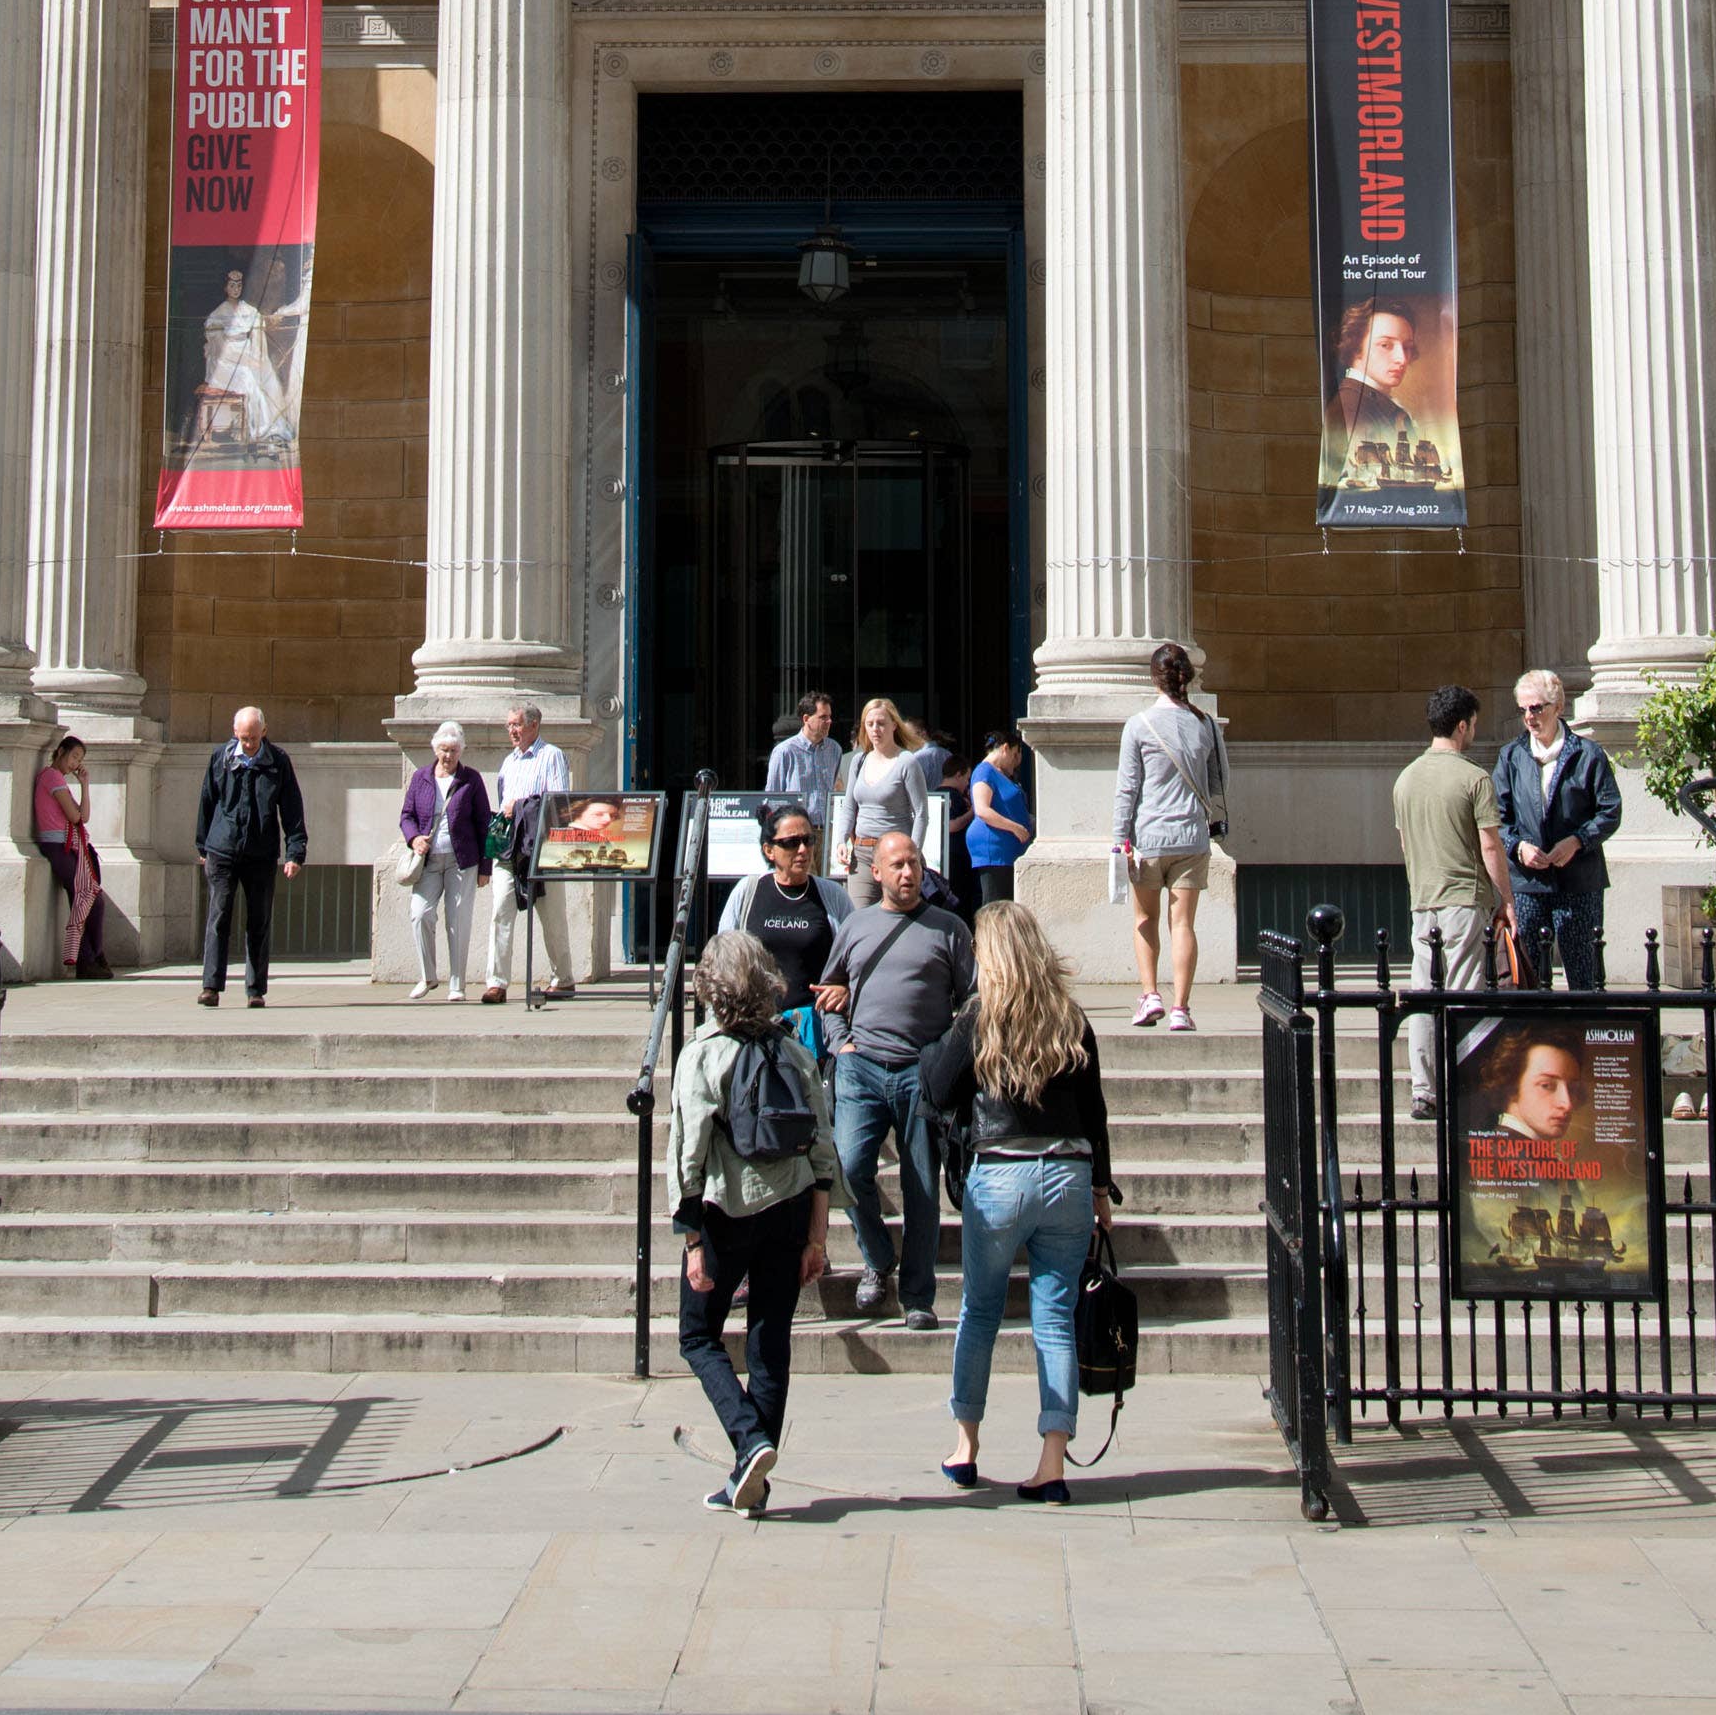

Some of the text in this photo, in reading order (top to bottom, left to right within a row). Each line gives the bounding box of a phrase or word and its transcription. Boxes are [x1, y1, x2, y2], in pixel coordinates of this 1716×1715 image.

[190, 7, 291, 45] MANET
[189, 48, 307, 87] FOR THE
[188, 90, 292, 129] PUBLIC
[187, 133, 251, 171] GIVE
[185, 175, 254, 213] NOW
[1343, 254, 1420, 268] An Episode of
[1343, 268, 1426, 280] the Grand Tour
[169, 503, 293, 515] www.ashmolean.org/manet
[1344, 505, 1355, 514] 17
[1396, 504, 1414, 517] Aug
[1416, 504, 1439, 514] 2012
[764, 919, 809, 929] ICELAND
[1585, 1030, 1634, 1042] ASHMOLEAN
[1478, 1130, 1495, 1138] English
[1469, 1139, 1578, 1158] THE CAPTURE OF
[1469, 1160, 1602, 1180] THE WESTMORLAND
